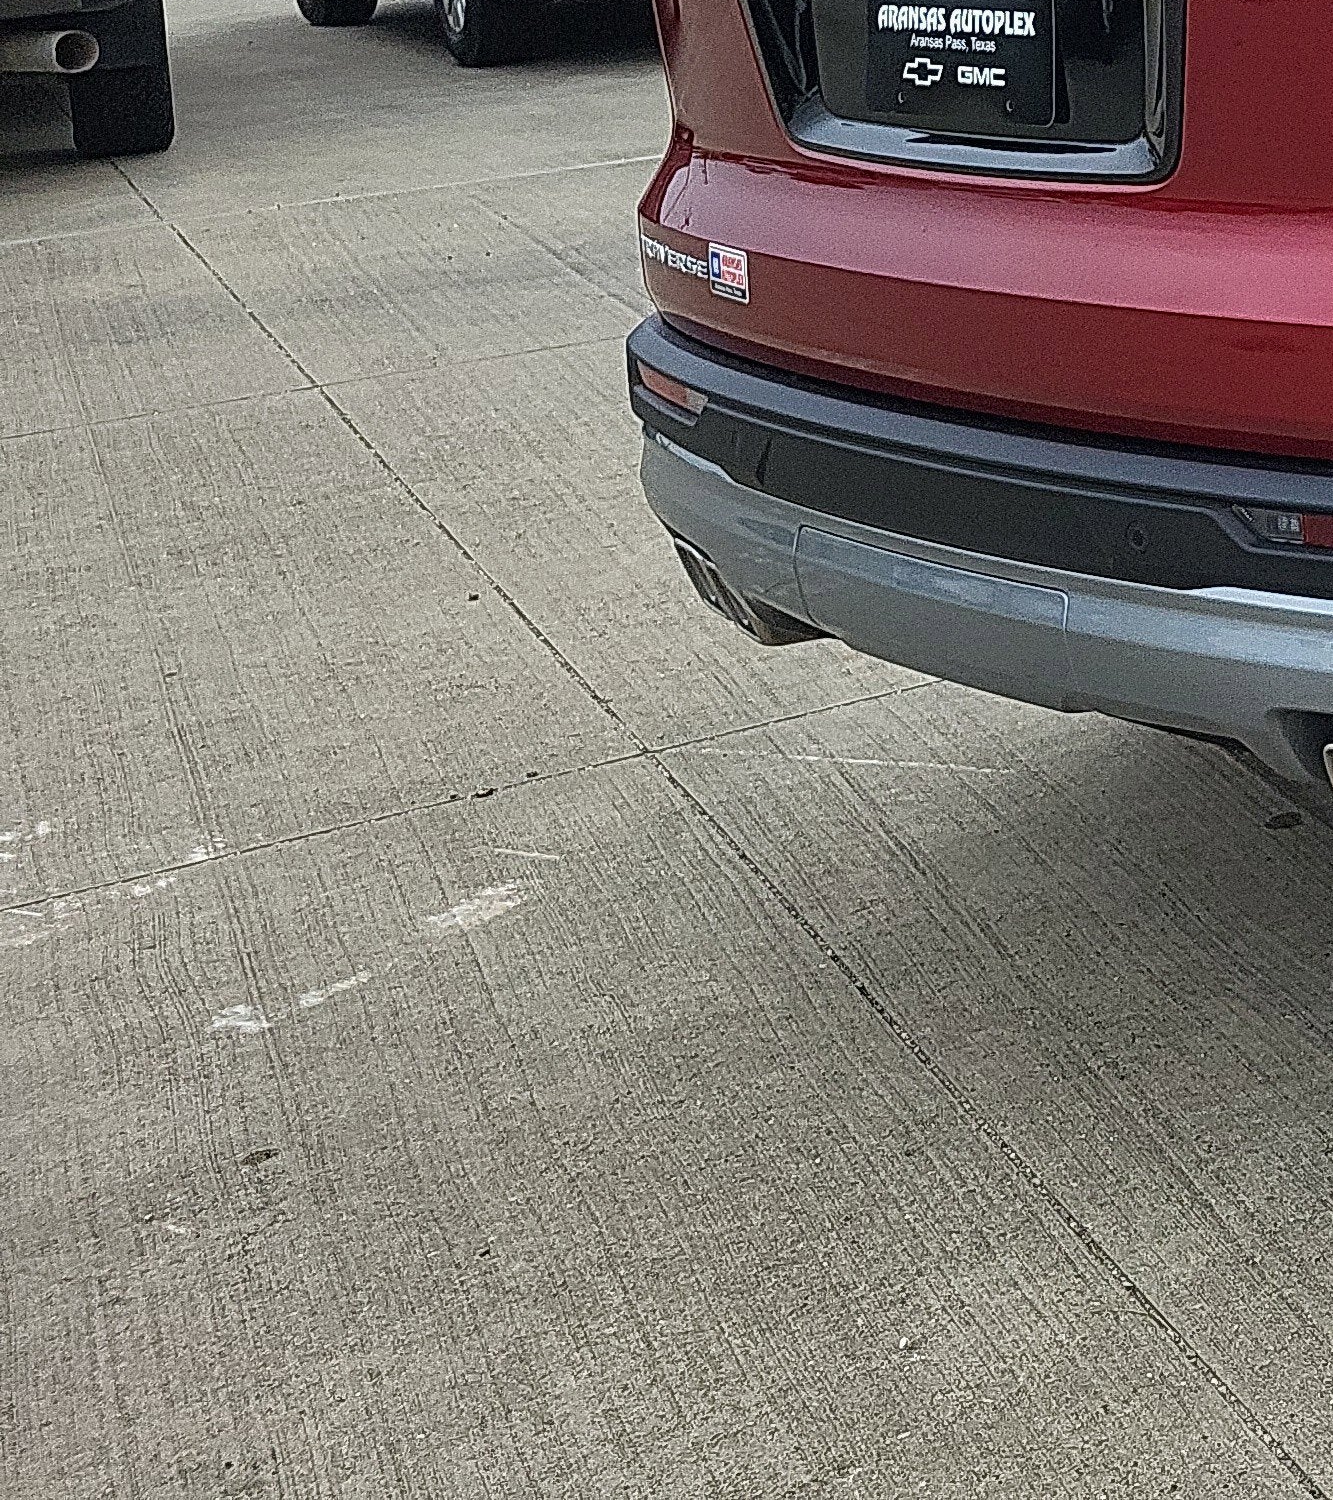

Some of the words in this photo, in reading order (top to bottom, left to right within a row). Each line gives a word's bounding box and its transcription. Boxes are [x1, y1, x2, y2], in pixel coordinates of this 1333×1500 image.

[877, 4, 947, 33] ARANSAS
[950, 8, 1036, 37] AUTOPLEX
[910, 33, 943, 50] Aransas
[945, 35, 969, 53] Pass,
[971, 36, 996, 52] Texas
[957, 65, 1006, 87] GMC
